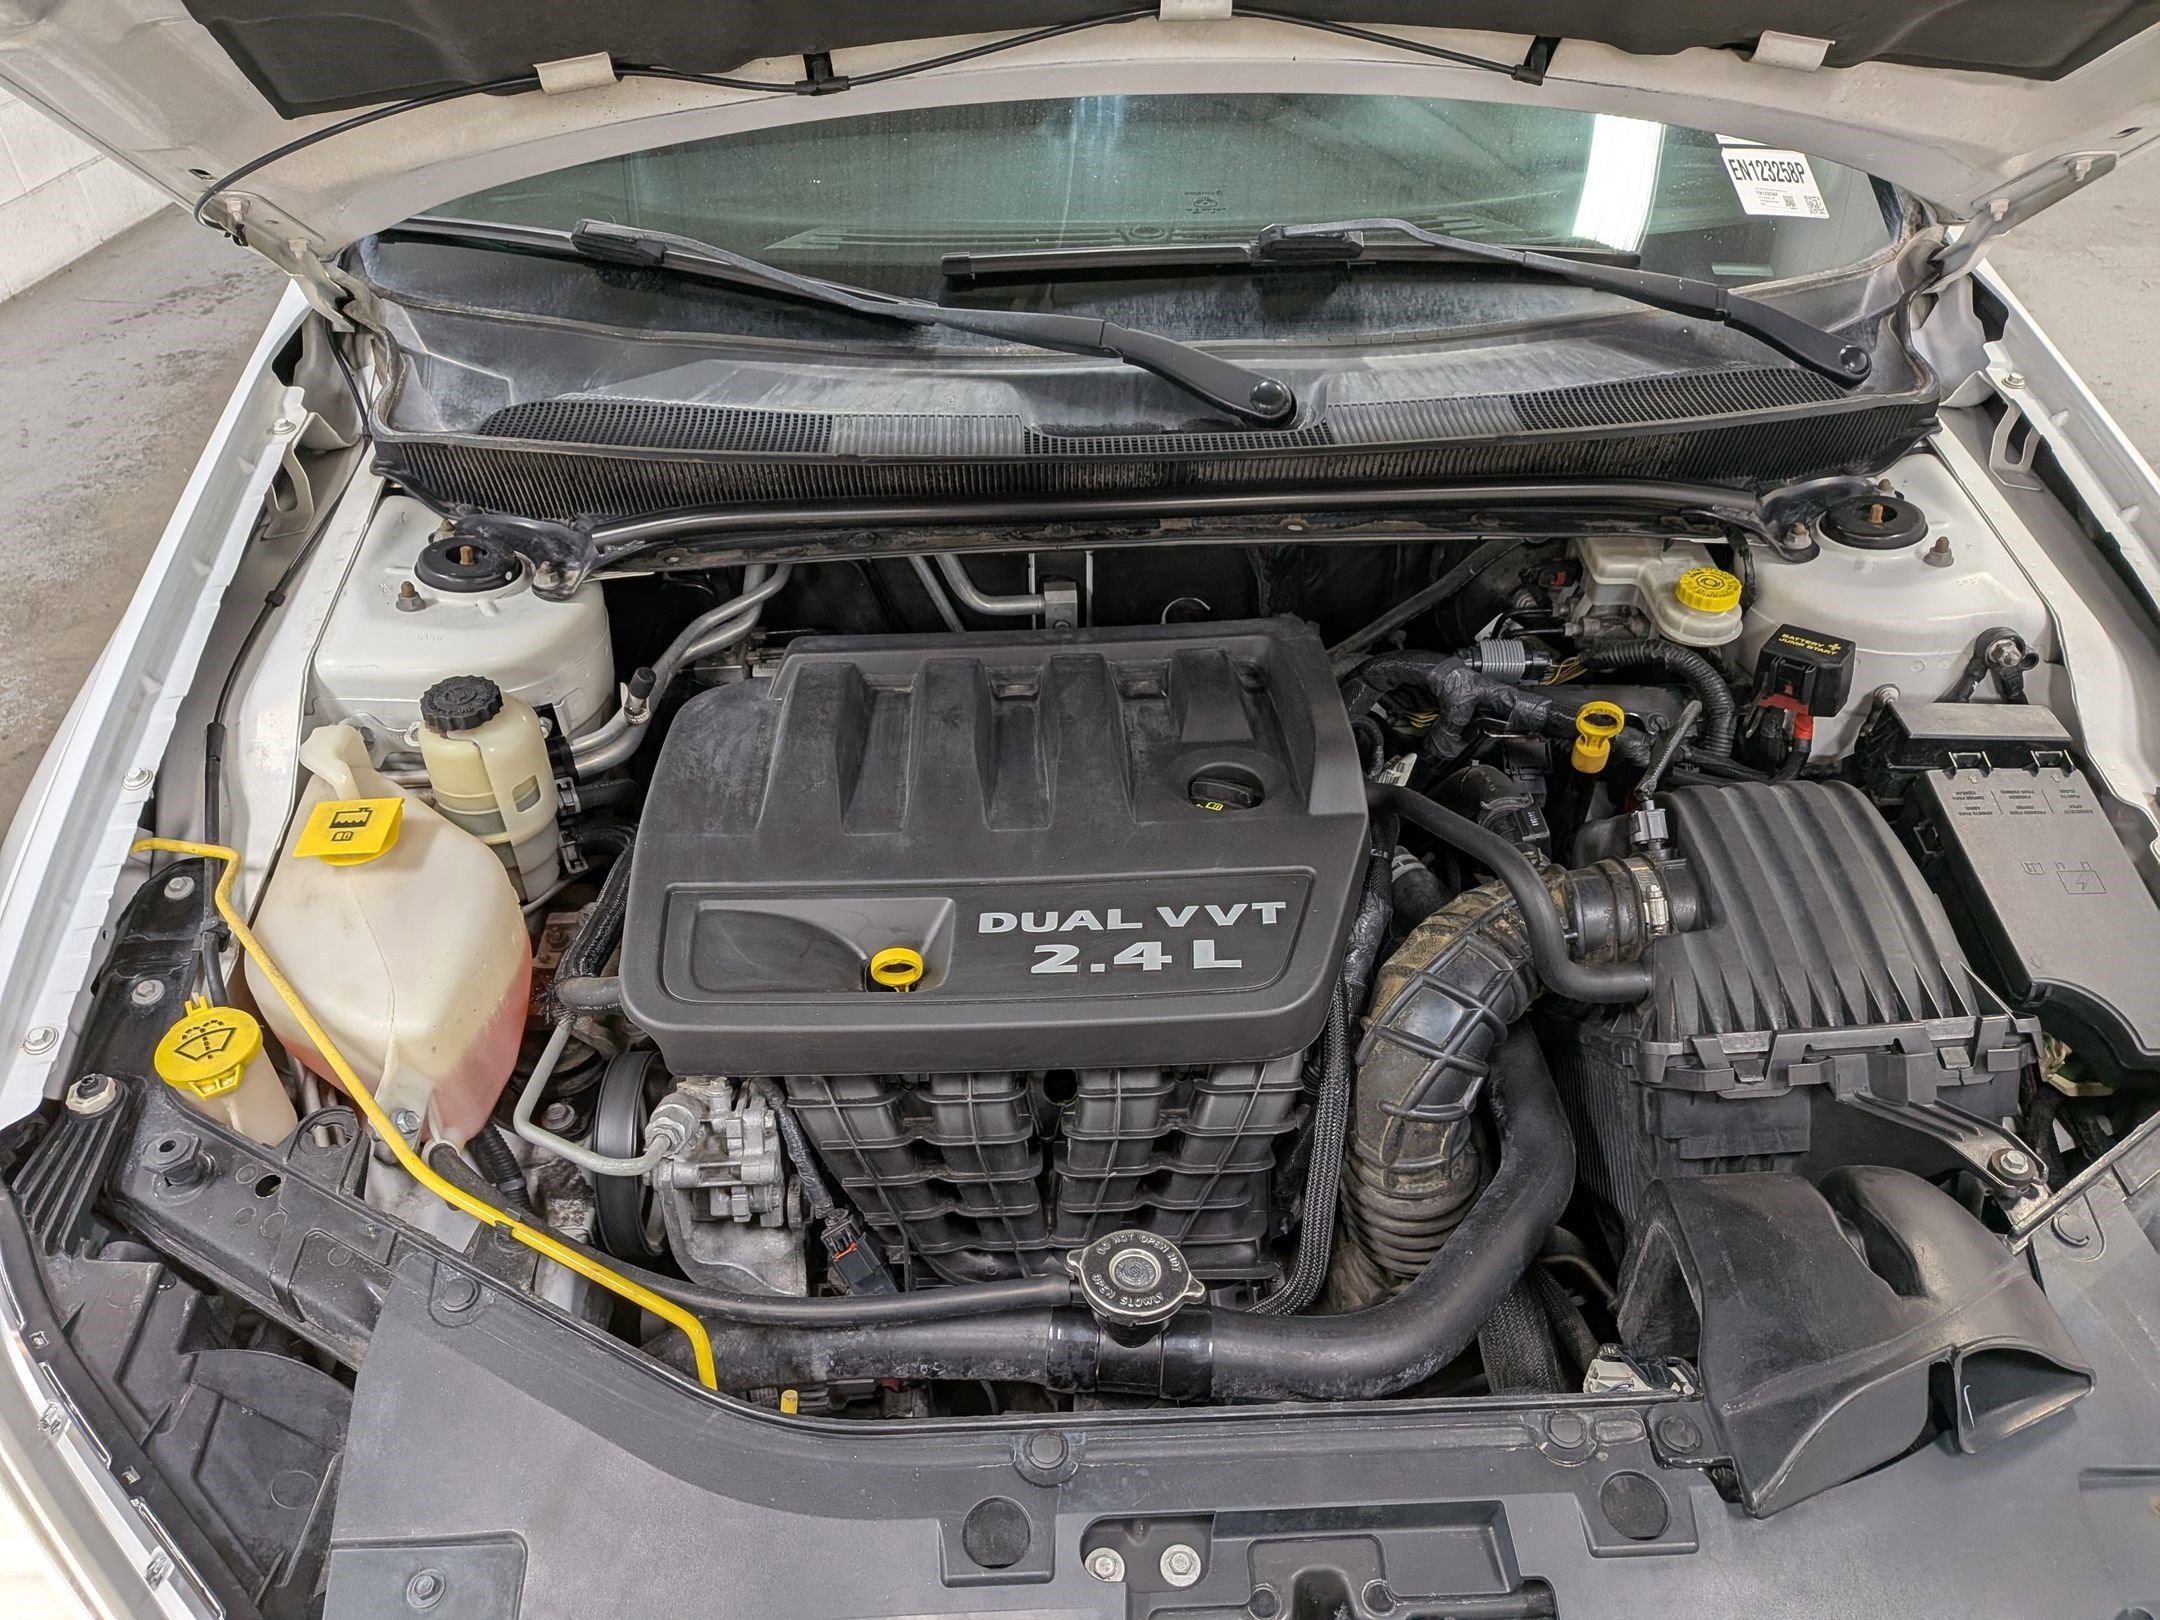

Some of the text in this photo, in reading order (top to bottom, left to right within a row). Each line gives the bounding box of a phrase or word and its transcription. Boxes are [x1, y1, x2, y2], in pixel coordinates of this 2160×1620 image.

[1728, 158, 1805, 184] EN123258P
[1779, 637, 1837, 655] JUMP START
[1781, 633, 1824, 647] BATTERY
[978, 901, 1287, 934] DUAL VVT
[1096, 1242, 1112, 1256] DO
[1114, 1234, 1134, 1244] NOT
[1141, 1235, 1169, 1253] OPEN
[1120, 1292, 1164, 1307] SLOWLY
